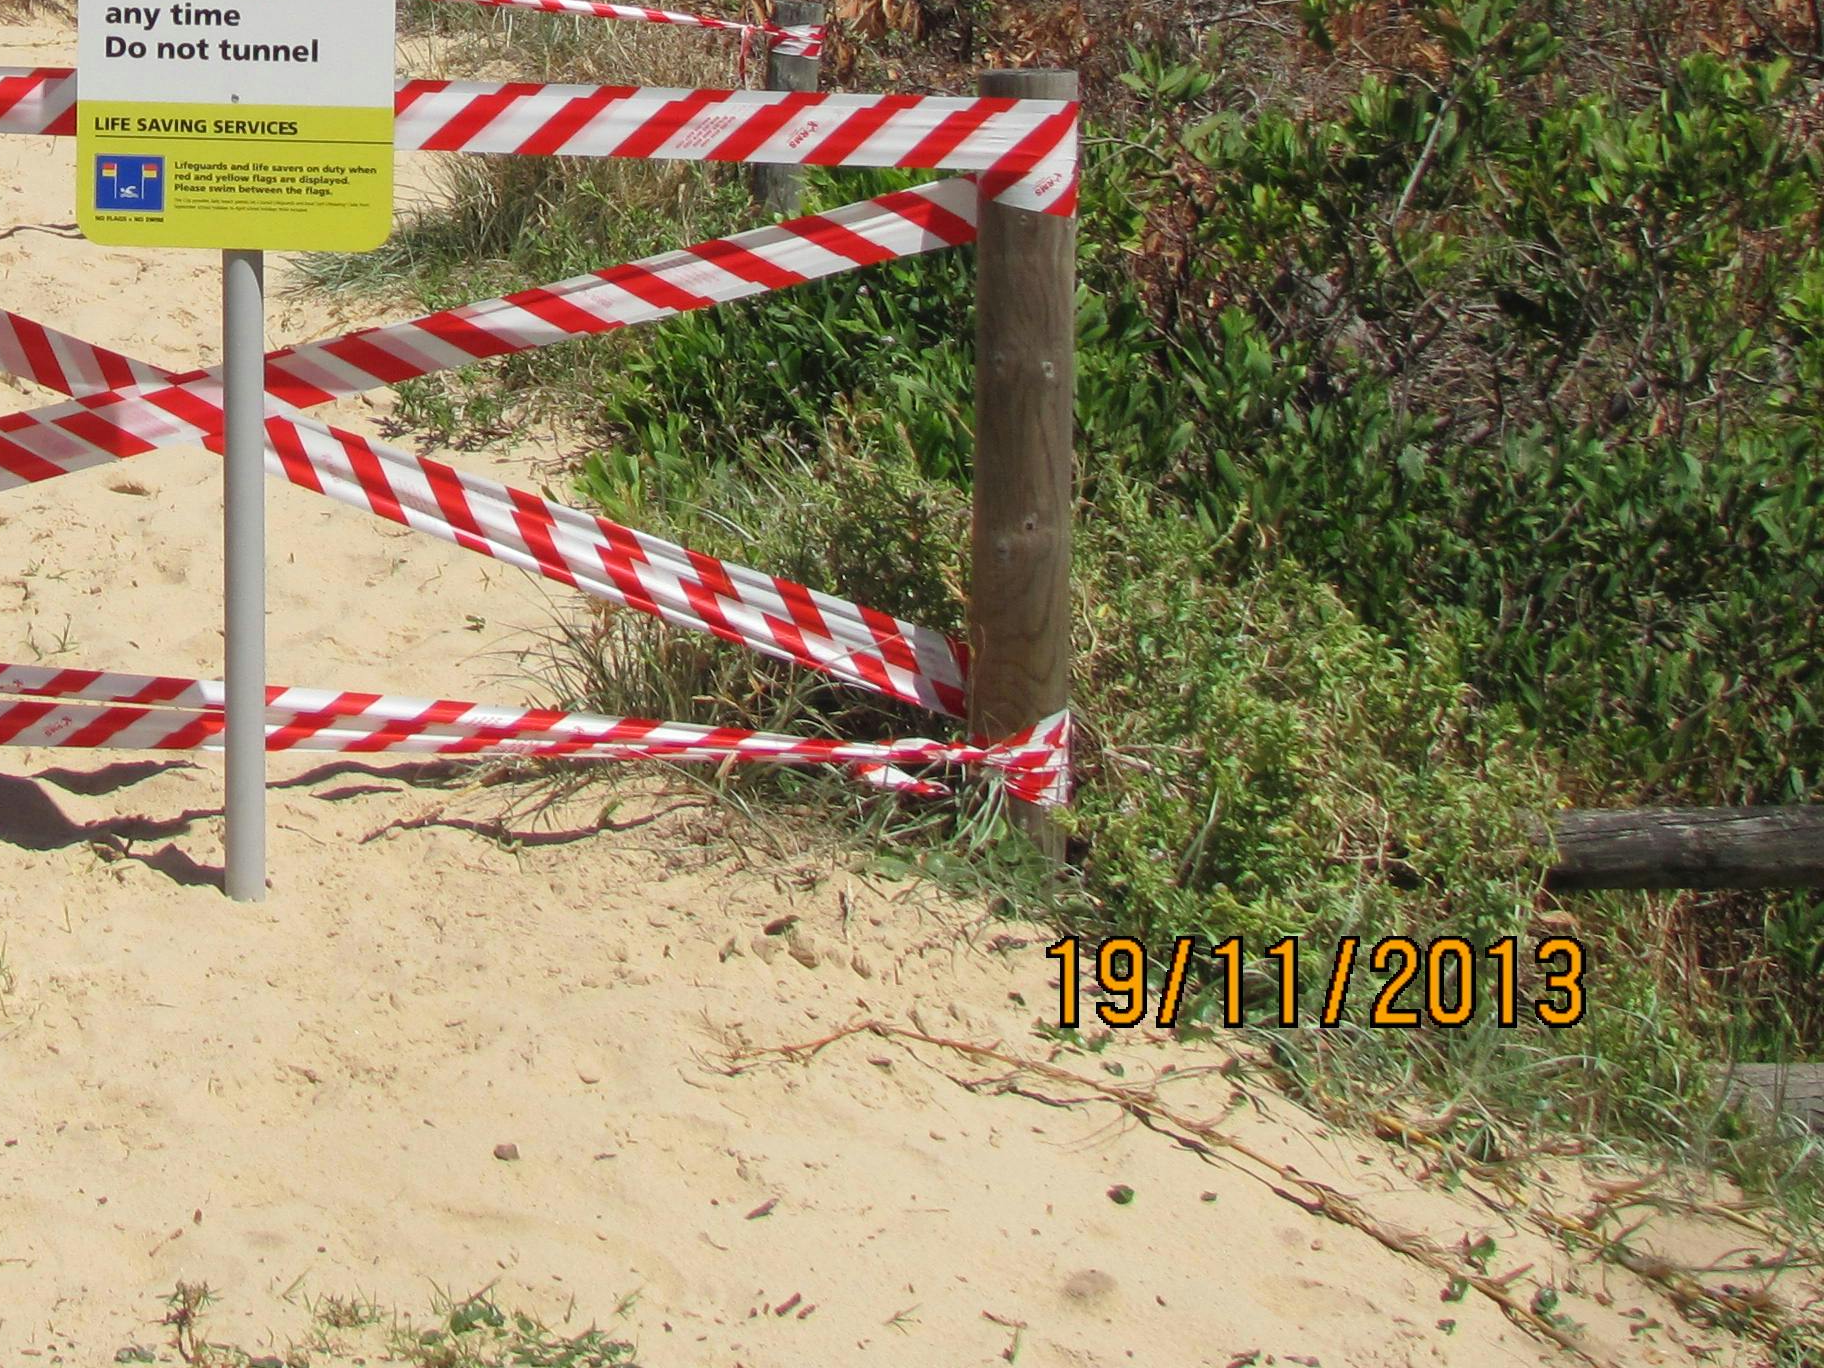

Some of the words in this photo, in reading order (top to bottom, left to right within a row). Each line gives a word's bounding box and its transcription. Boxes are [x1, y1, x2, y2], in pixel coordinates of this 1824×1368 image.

[105, 7, 161, 30] any
[170, 3, 241, 26] time
[105, 36, 147, 58] Do
[157, 39, 209, 60] not
[218, 40, 318, 62] tunnel
[94, 117, 131, 131] LIFE
[137, 118, 207, 133] SAVING
[213, 120, 298, 135] SERVICES
[174, 161, 228, 171] Lifeguards
[230, 163, 250, 171] and
[252, 163, 269, 171] life
[322, 165, 346, 174] duty
[348, 166, 377, 174] when
[174, 172, 191, 181] red
[193, 172, 213, 181] and
[215, 173, 250, 183] yellow
[252, 174, 277, 184] flags
[298, 173, 350, 185] displayed.
[174, 183, 206, 192] Please
[208, 184, 236, 193] swim
[238, 184, 283, 194] between
[285, 186, 302, 195] the
[305, 184, 333, 196] flags.
